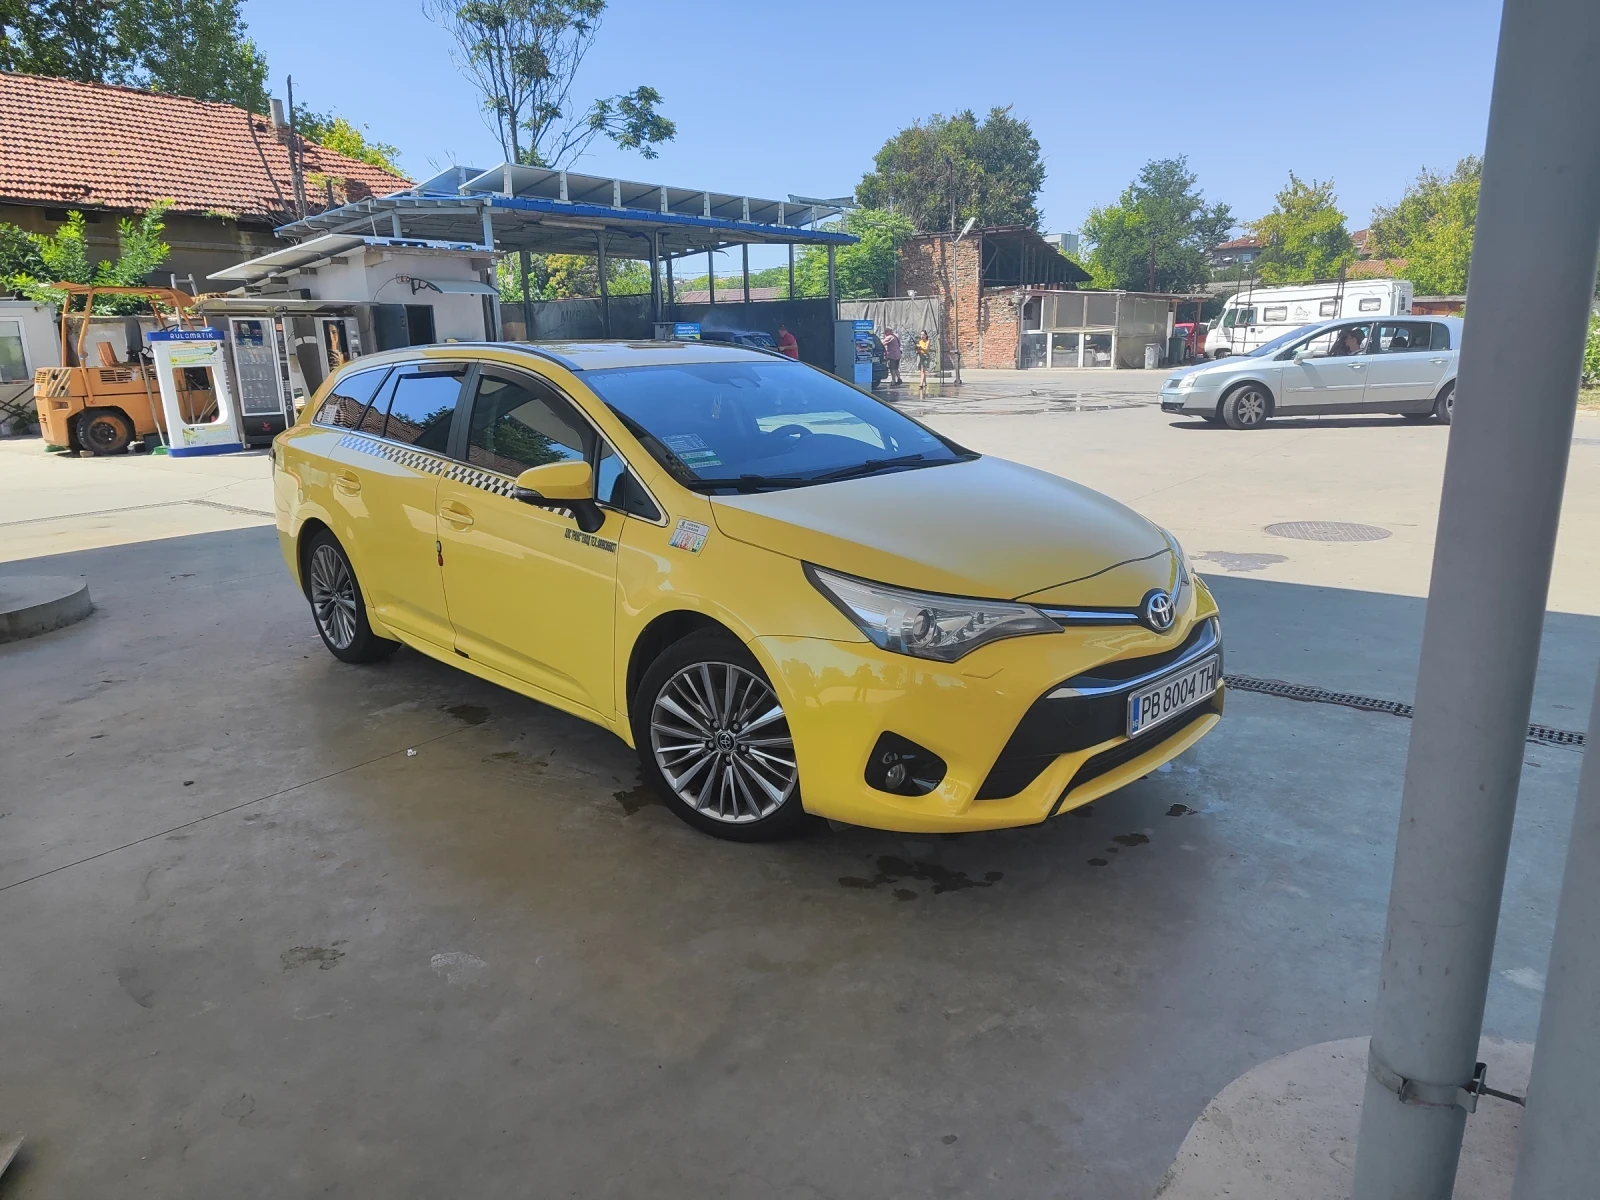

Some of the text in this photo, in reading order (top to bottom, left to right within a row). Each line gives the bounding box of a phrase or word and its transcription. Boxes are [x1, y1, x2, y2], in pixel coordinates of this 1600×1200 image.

[1141, 663, 1216, 725] PB 8004 TH
